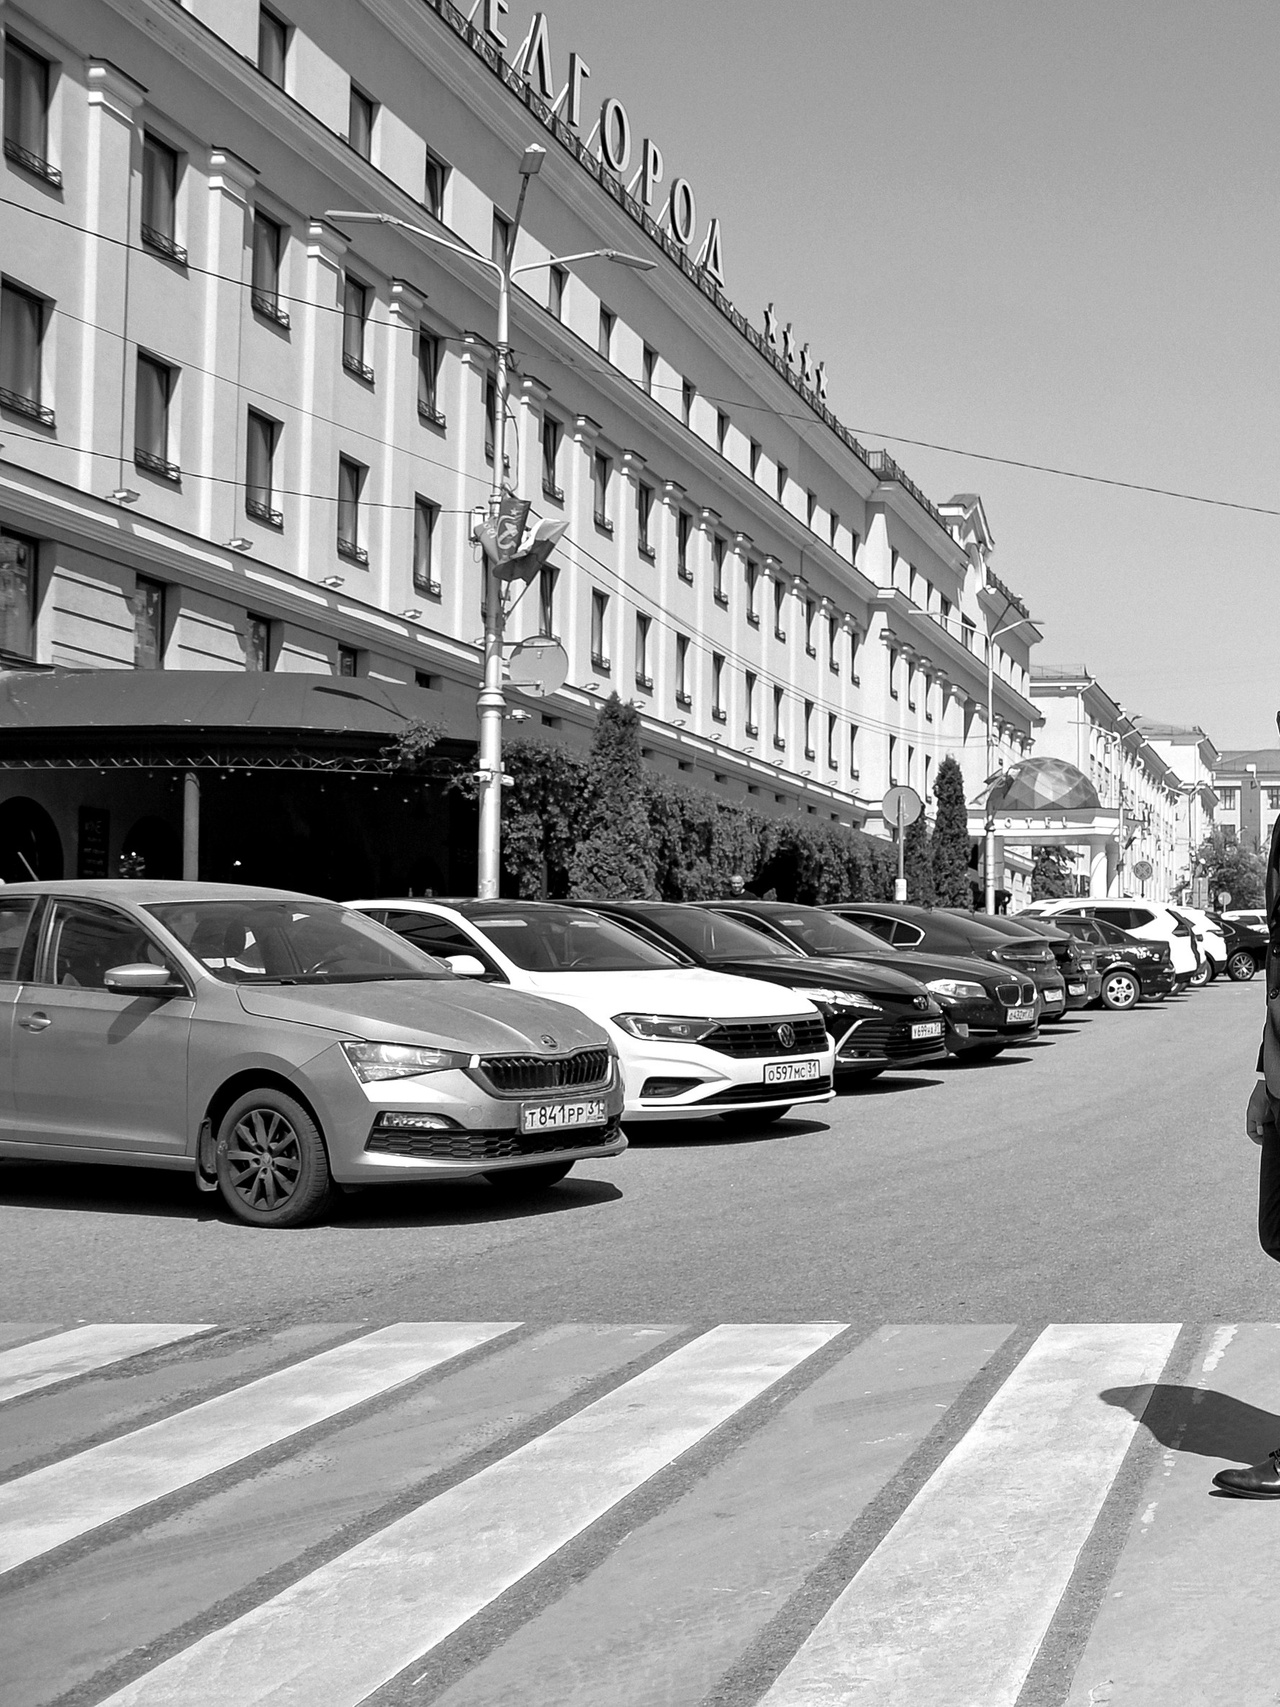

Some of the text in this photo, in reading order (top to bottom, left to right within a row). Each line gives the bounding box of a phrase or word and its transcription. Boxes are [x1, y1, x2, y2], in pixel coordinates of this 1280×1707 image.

[807, 1062, 817, 1073] 31
[528, 1101, 601, 1127] Т841РР 31
